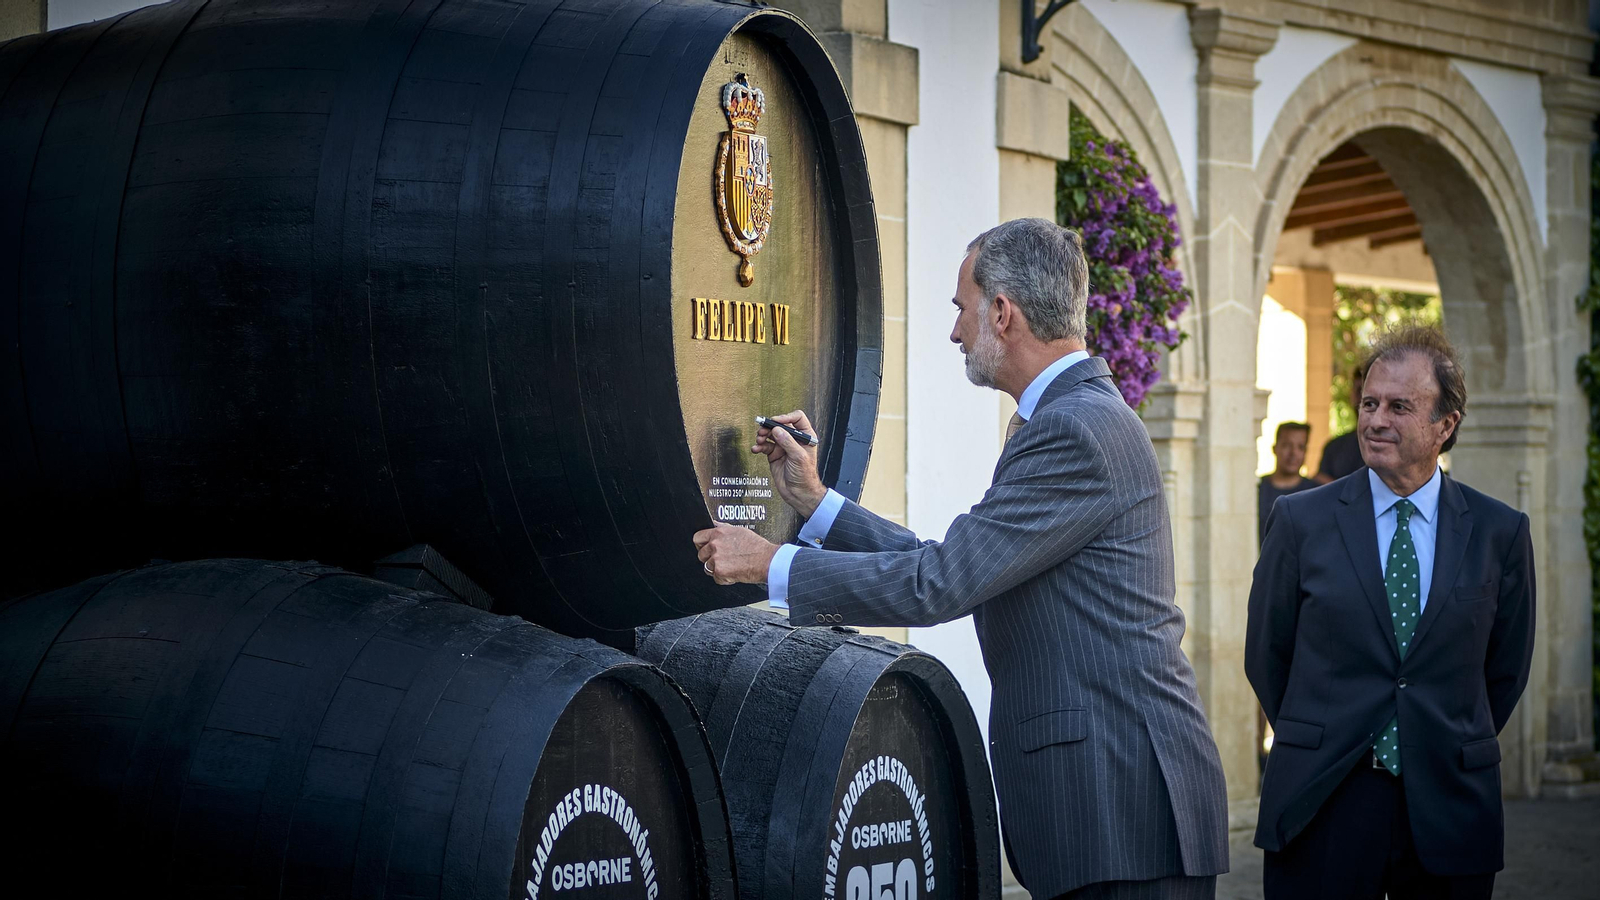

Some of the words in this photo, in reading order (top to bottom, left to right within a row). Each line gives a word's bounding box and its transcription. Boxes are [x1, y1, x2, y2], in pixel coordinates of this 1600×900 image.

[691, 297, 766, 344] FELIPE
[770, 303, 790, 345] VI
[708, 488, 732, 498] NUESTRO
[744, 489, 772, 498] ANIVERSARIO
[712, 476, 720, 486] EN
[721, 475, 762, 486] CONMEMORACIÓN
[762, 477, 769, 487] DE
[851, 819, 912, 850] OSBORNE
[876, 755, 936, 893] GASTRONÓMICOS
[551, 856, 632, 892] OSBORNE
